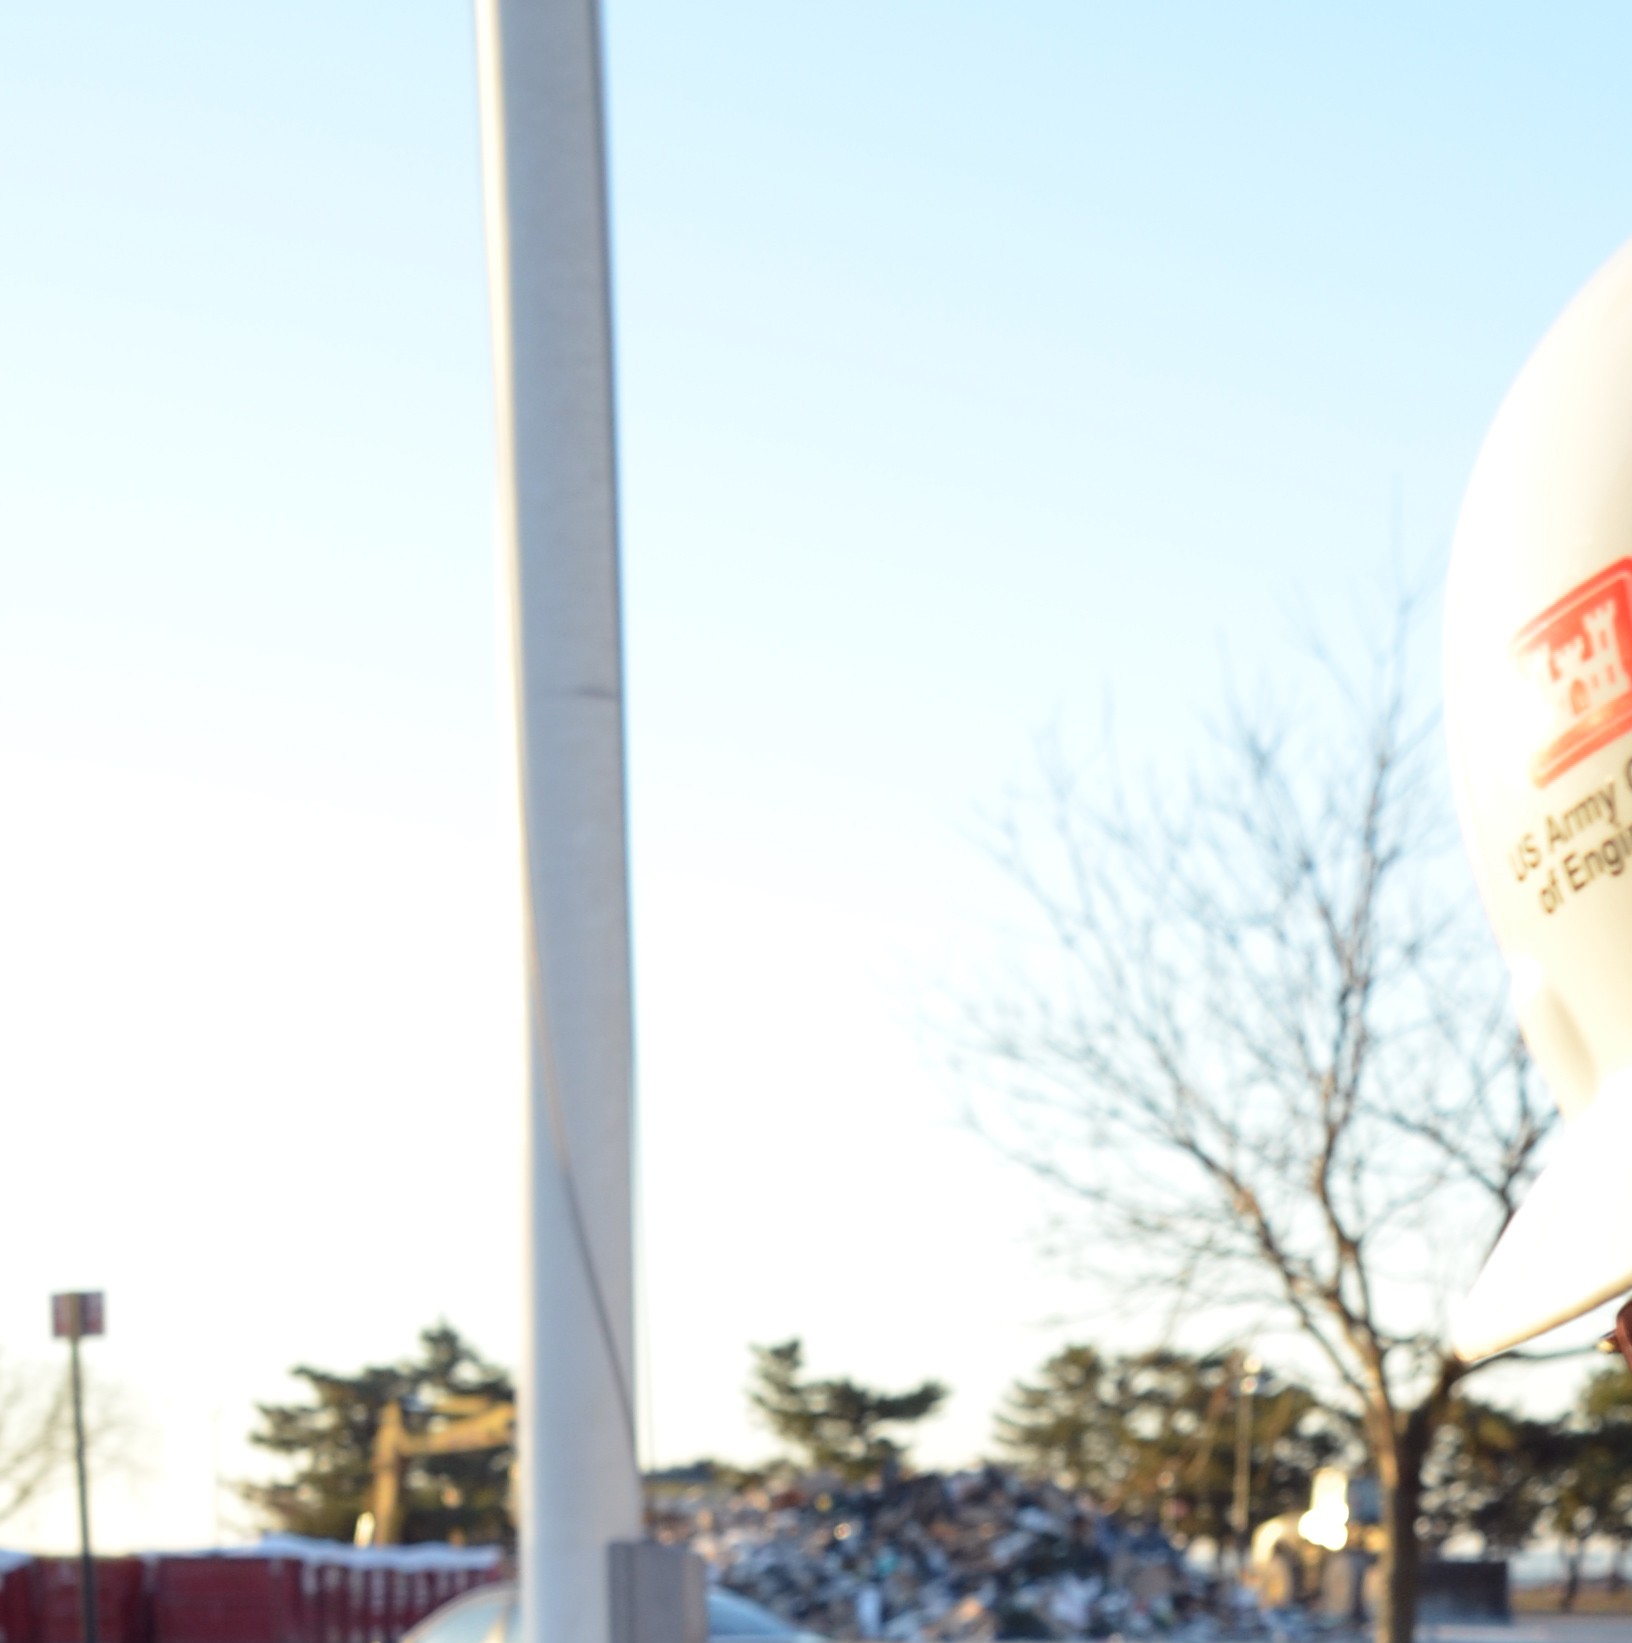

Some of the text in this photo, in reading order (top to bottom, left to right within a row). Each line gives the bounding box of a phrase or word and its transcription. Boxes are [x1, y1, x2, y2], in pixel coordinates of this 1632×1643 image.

[1508, 833, 1542, 882] US
[1545, 779, 1621, 851] Army
[1540, 868, 1564, 914] of
